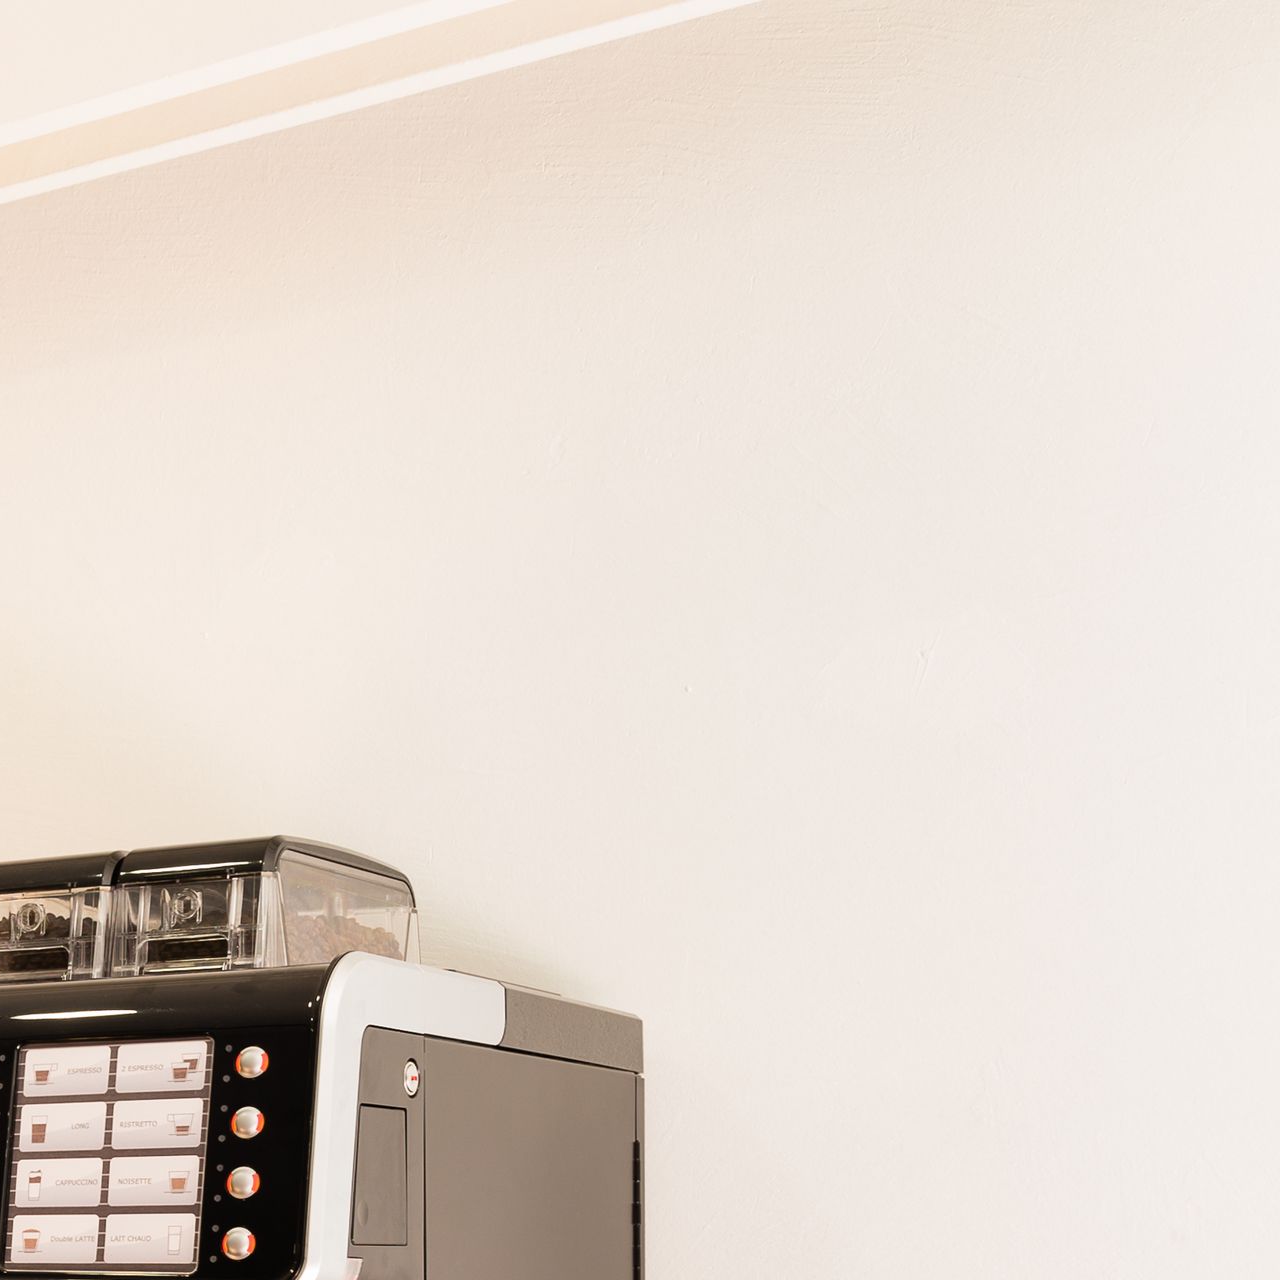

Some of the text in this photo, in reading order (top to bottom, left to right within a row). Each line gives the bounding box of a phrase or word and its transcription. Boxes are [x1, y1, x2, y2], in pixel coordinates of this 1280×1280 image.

[67, 1066, 102, 1075] ESPRESSO
[121, 1064, 164, 1073] 2 ESPRESSO
[71, 1122, 90, 1130] LONG
[119, 1120, 158, 1128] RISTRETTO
[55, 1178, 99, 1186] CAPPUCCINO
[117, 1177, 152, 1185] NOISETTE
[50, 1234, 96, 1243] Double LATTE
[110, 1234, 152, 1242] LAIT CHAUD
